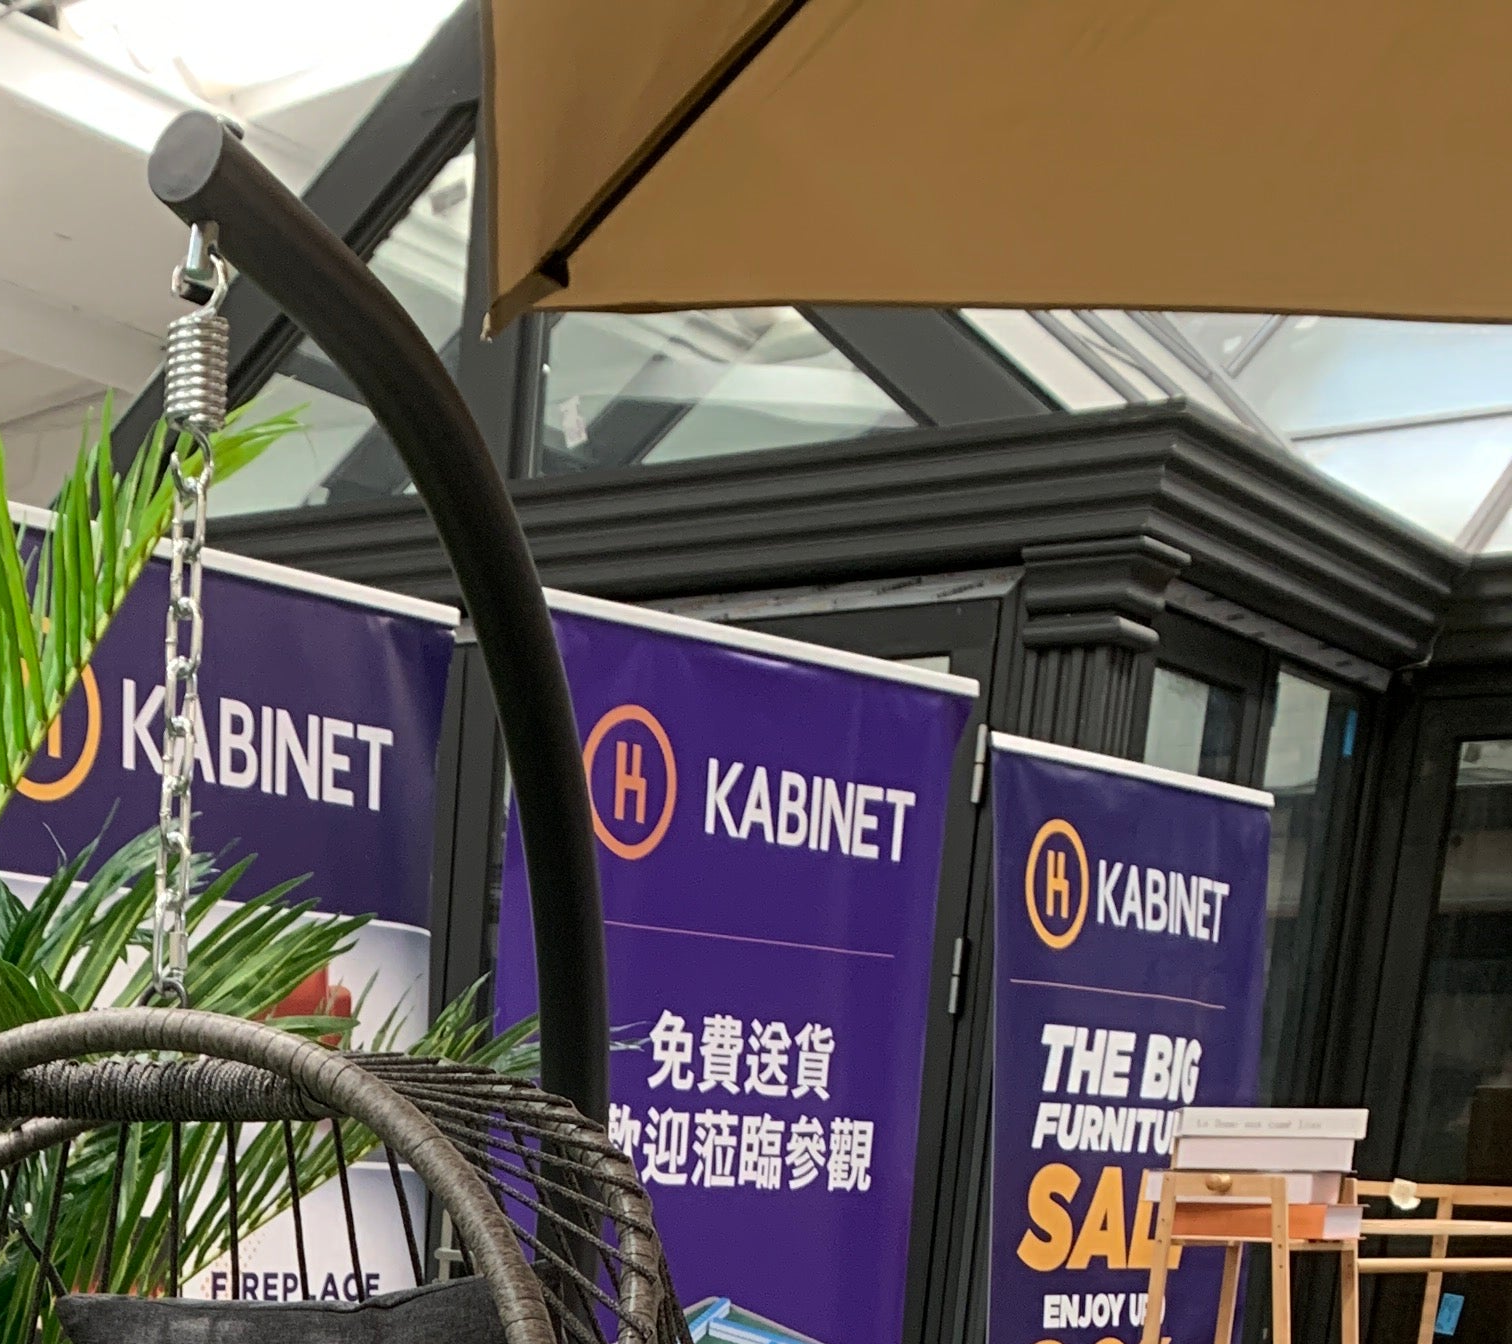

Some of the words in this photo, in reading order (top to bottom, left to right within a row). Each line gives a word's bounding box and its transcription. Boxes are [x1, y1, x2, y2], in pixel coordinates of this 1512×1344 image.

[704, 758, 915, 862] KABINET
[1096, 859, 1230, 943] KABINET
[647, 1009, 835, 1101] 免費送貨
[1041, 1024, 1136, 1097] THE
[1140, 1034, 1202, 1104] BIG
[1031, 1102, 1174, 1155] FURNITU
[1043, 1293, 1126, 1328] ENJOY
